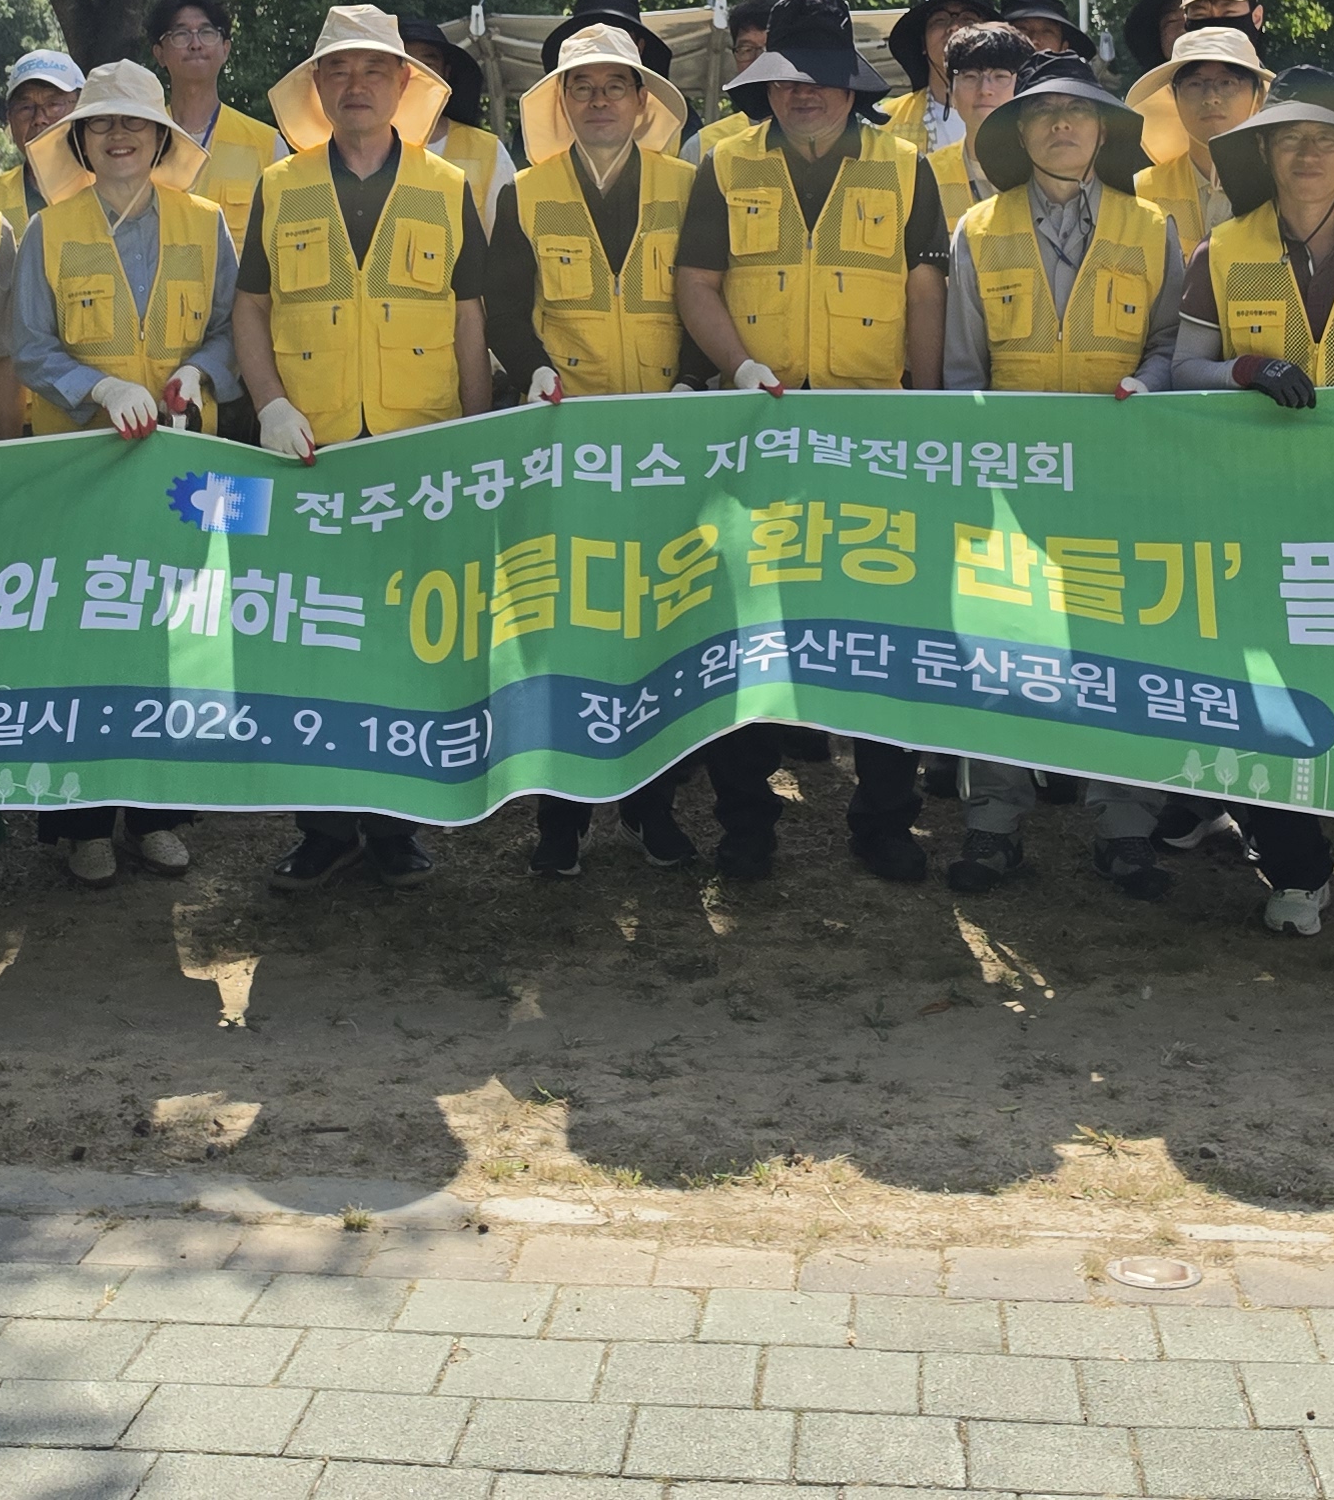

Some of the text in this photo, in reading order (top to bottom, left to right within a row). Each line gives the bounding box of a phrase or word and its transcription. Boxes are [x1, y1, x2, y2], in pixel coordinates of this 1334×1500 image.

[294, 427, 1074, 535] 전주상공회의소 지역발전위원회
[79, 554, 365, 652] 함께하는
[747, 501, 917, 587] 환경
[131, 699, 272, 745] 2026.
[293, 708, 337, 751] 9.
[359, 708, 494, 768] 18(금)
[578, 688, 661, 745] 장소
[698, 626, 896, 688] 완주산단
[912, 639, 1117, 714] 둔산공원
[1138, 674, 1241, 731] 일원
